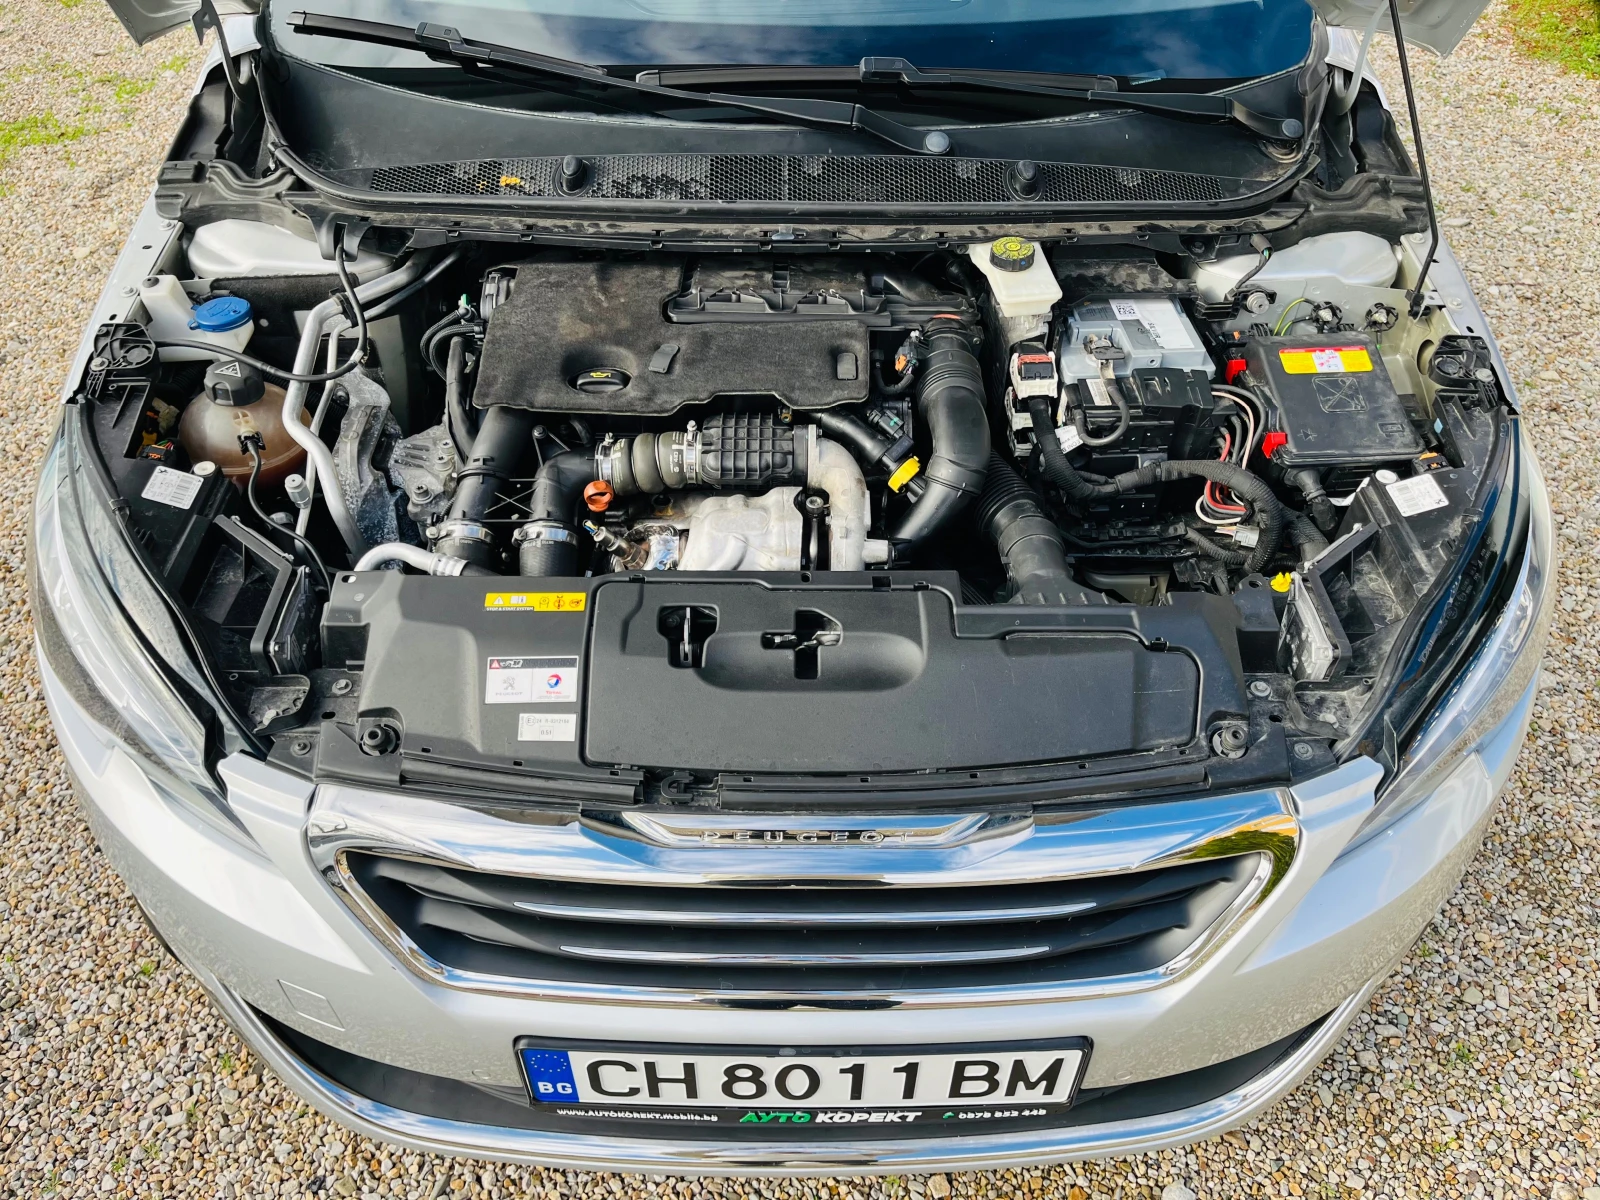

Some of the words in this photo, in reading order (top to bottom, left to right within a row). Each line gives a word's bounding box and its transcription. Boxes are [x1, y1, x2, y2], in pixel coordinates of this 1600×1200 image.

[700, 830, 915, 843] PEUGEOT
[586, 1059, 699, 1100] CH
[721, 1061, 920, 1101] 8011
[947, 1057, 1065, 1099] BM
[537, 1081, 573, 1095] BG
